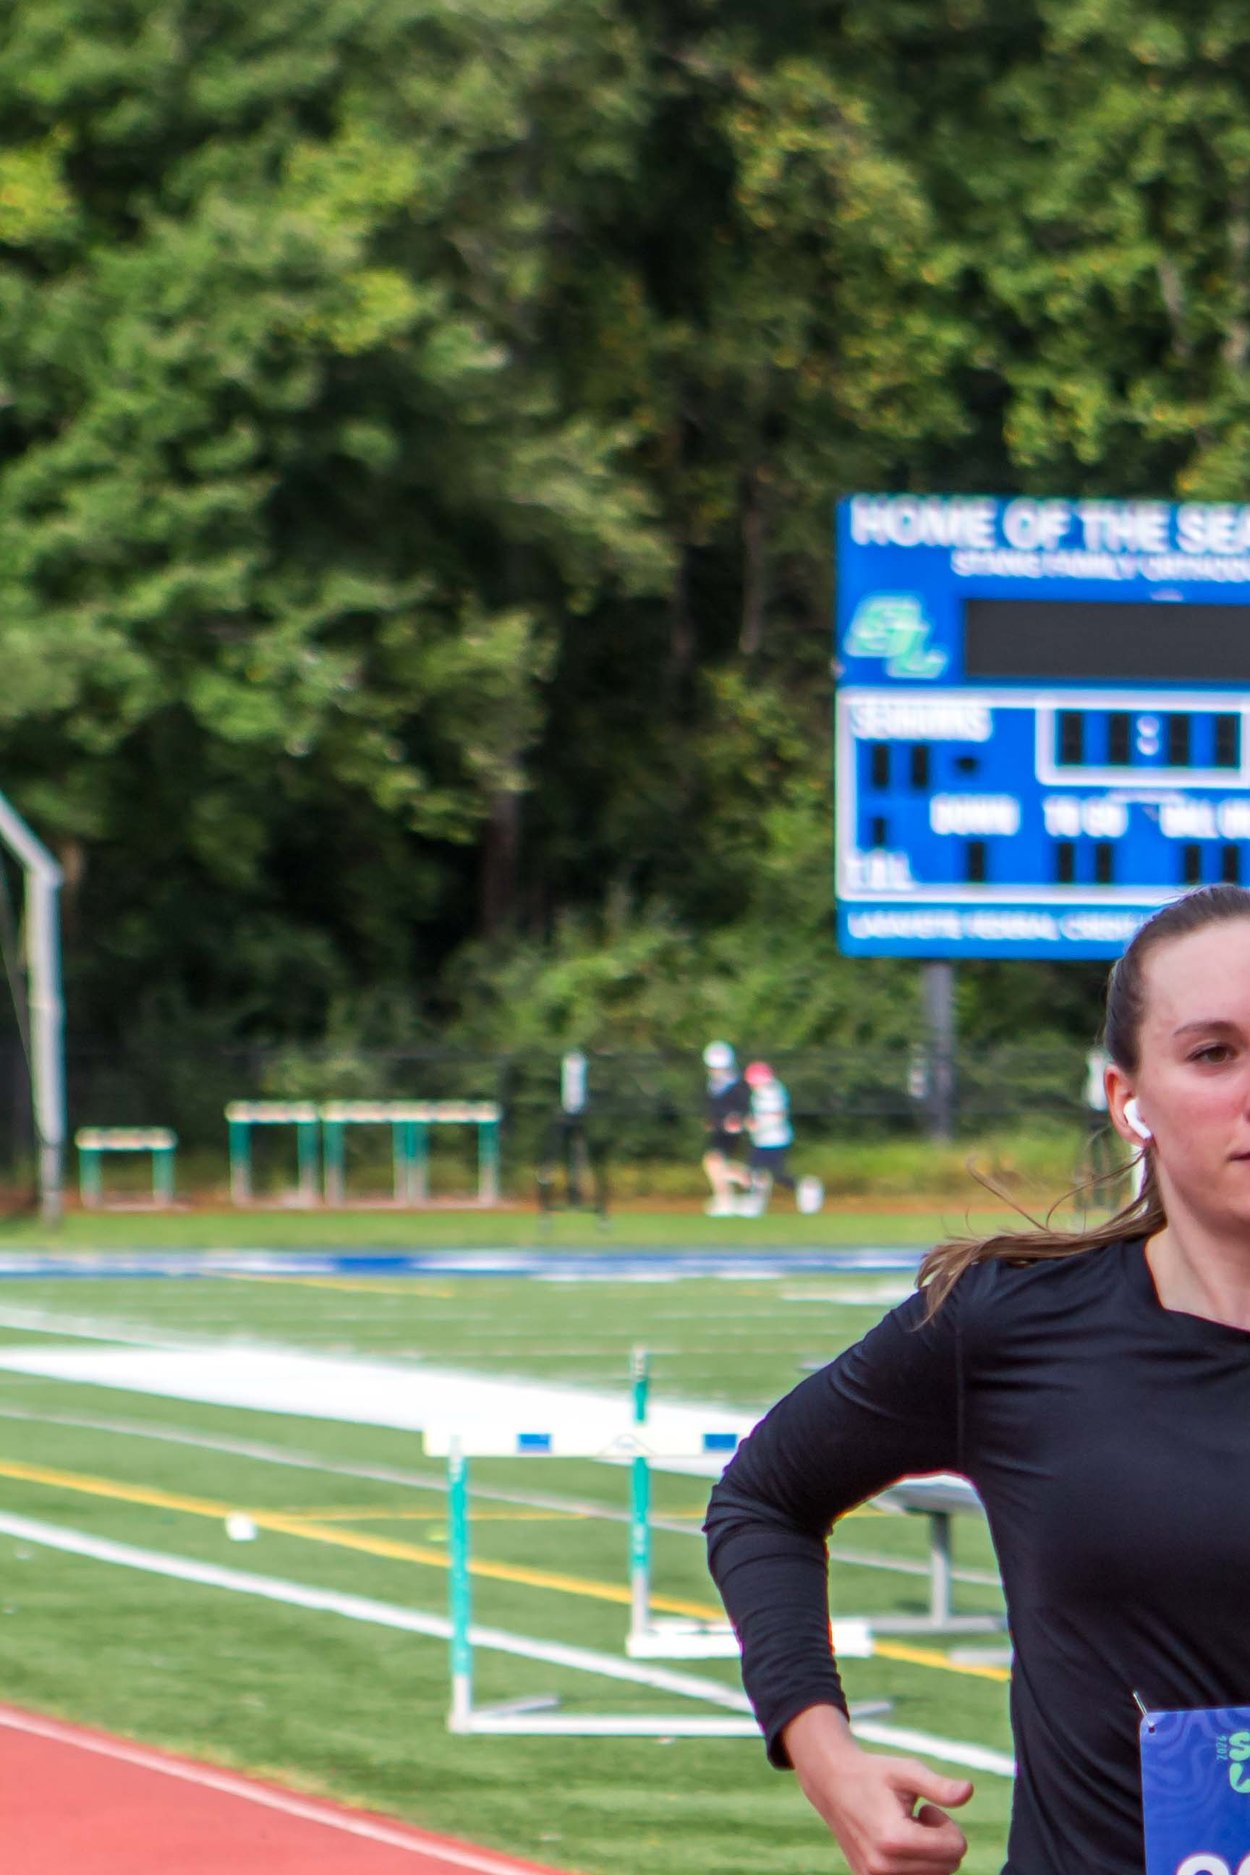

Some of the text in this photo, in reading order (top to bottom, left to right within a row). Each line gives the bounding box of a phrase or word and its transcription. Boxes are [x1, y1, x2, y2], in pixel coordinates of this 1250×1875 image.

[851, 498, 996, 548] HOME
[1003, 499, 1072, 550] OF
[1075, 501, 1172, 554] THE
